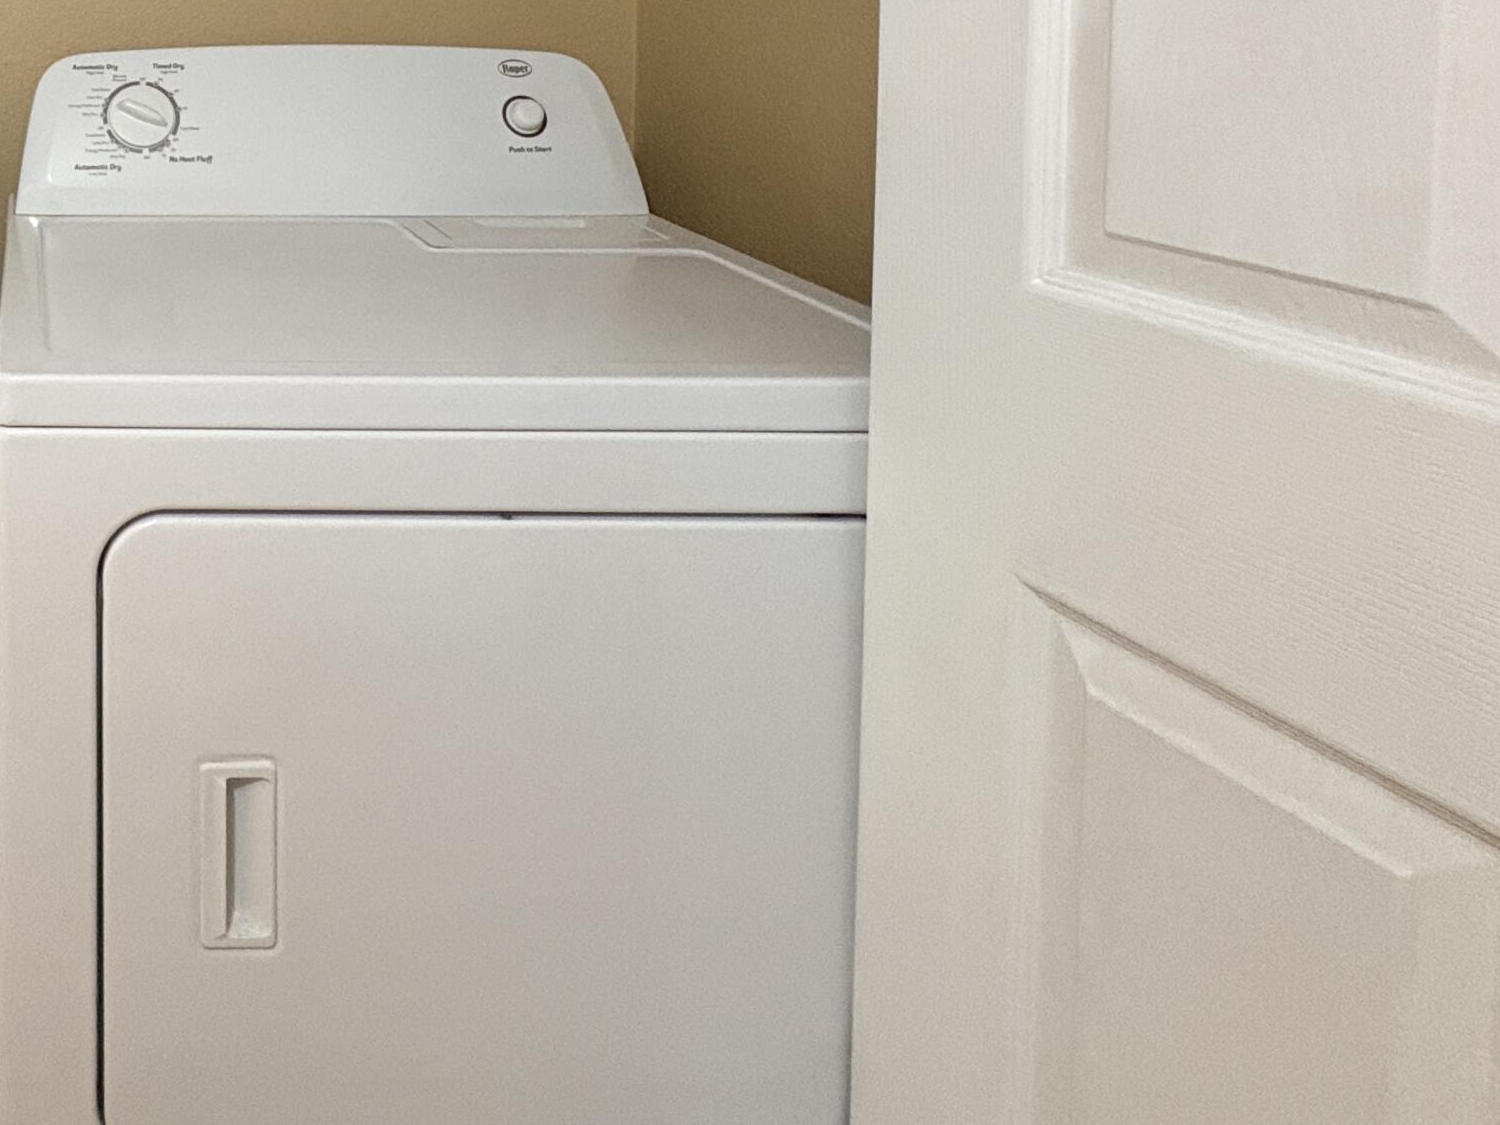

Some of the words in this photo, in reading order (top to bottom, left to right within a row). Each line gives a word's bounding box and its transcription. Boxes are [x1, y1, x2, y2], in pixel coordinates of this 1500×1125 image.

[106, 63, 119, 71] Dry
[172, 62, 185, 70] Dry
[502, 64, 528, 74] Roper
[508, 145, 525, 153] Push
[169, 155, 178, 163] No
[180, 155, 195, 163] Heat
[196, 155, 213, 164] Fluff
[74, 163, 108, 171] Automatic
[109, 163, 122, 172] Dry
